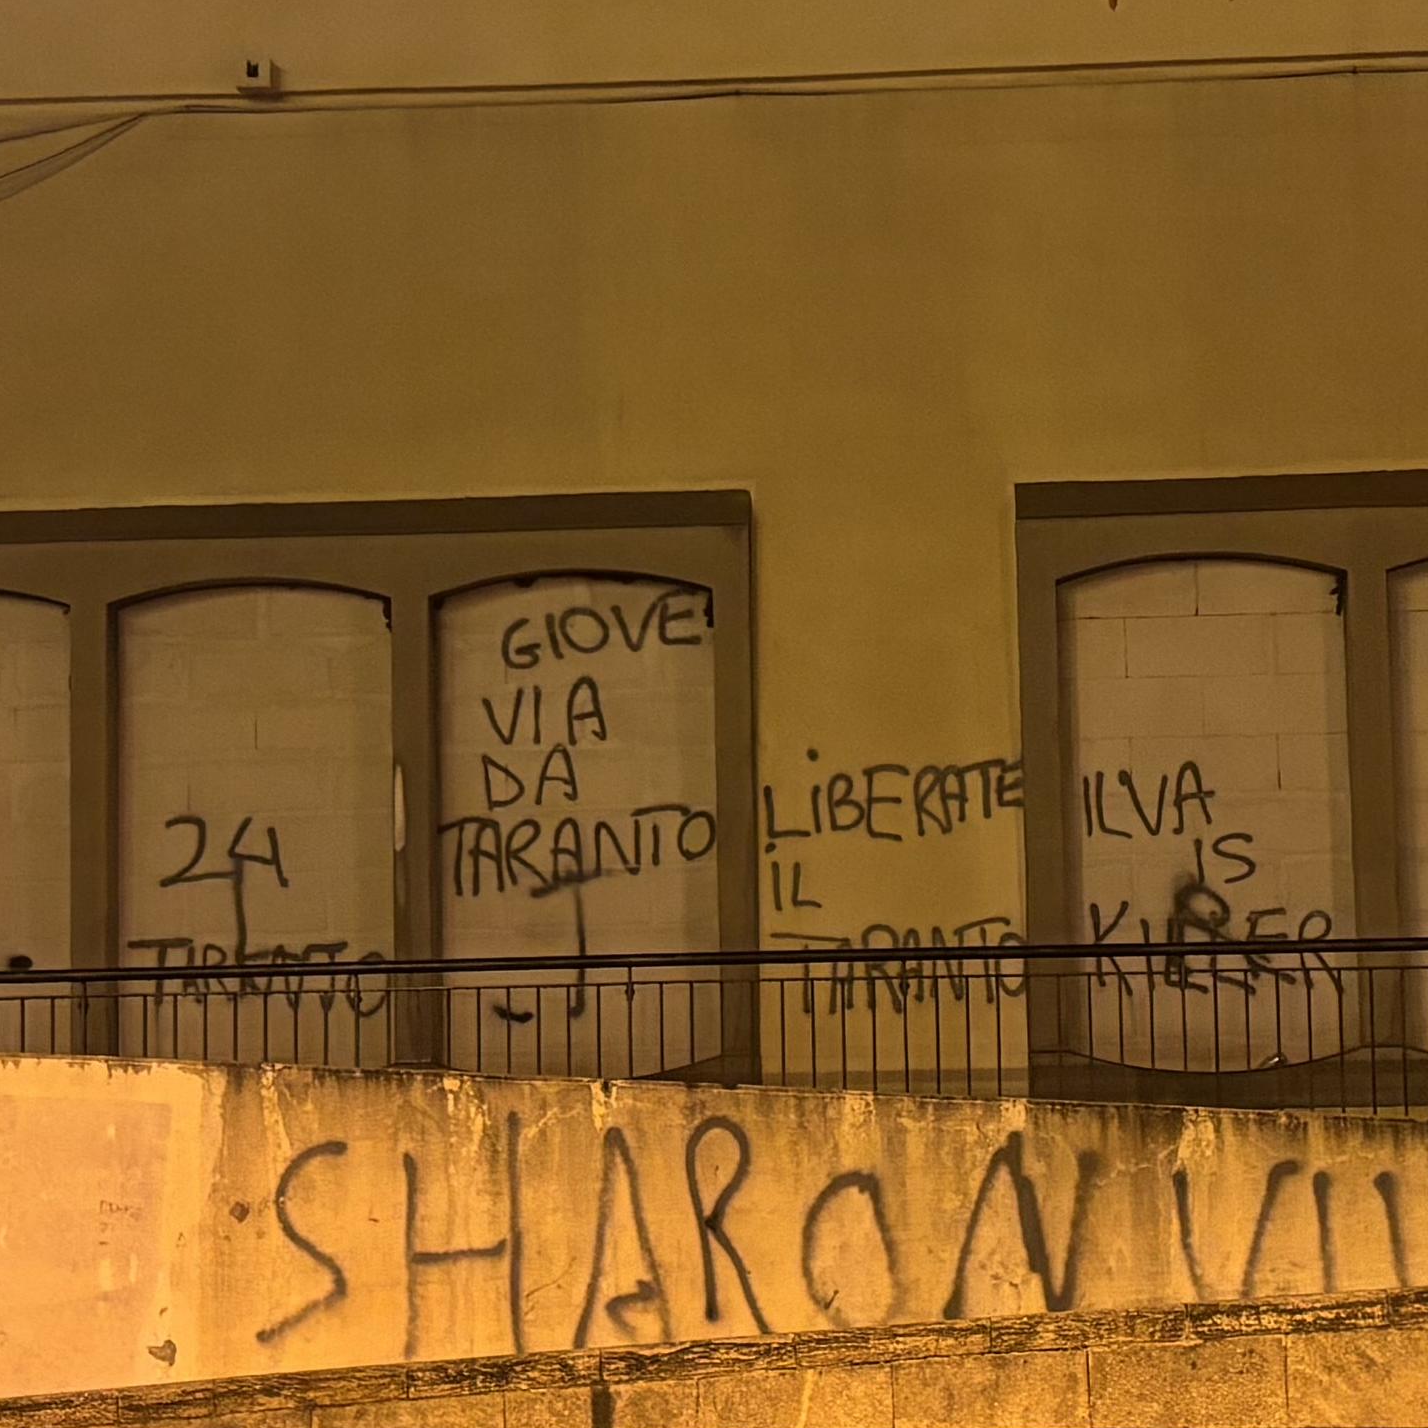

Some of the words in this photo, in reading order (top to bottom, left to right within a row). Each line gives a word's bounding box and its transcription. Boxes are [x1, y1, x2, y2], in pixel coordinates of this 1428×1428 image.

[501, 589, 703, 670] GIOVE
[481, 675, 607, 746] VIA
[481, 742, 578, 811] DA
[1082, 760, 1216, 839] ILVA
[159, 815, 290, 888] 24
[437, 804, 716, 897] TARANTO
[1194, 832, 1257, 885] IS
[254, 1111, 1102, 1358] SHARON
